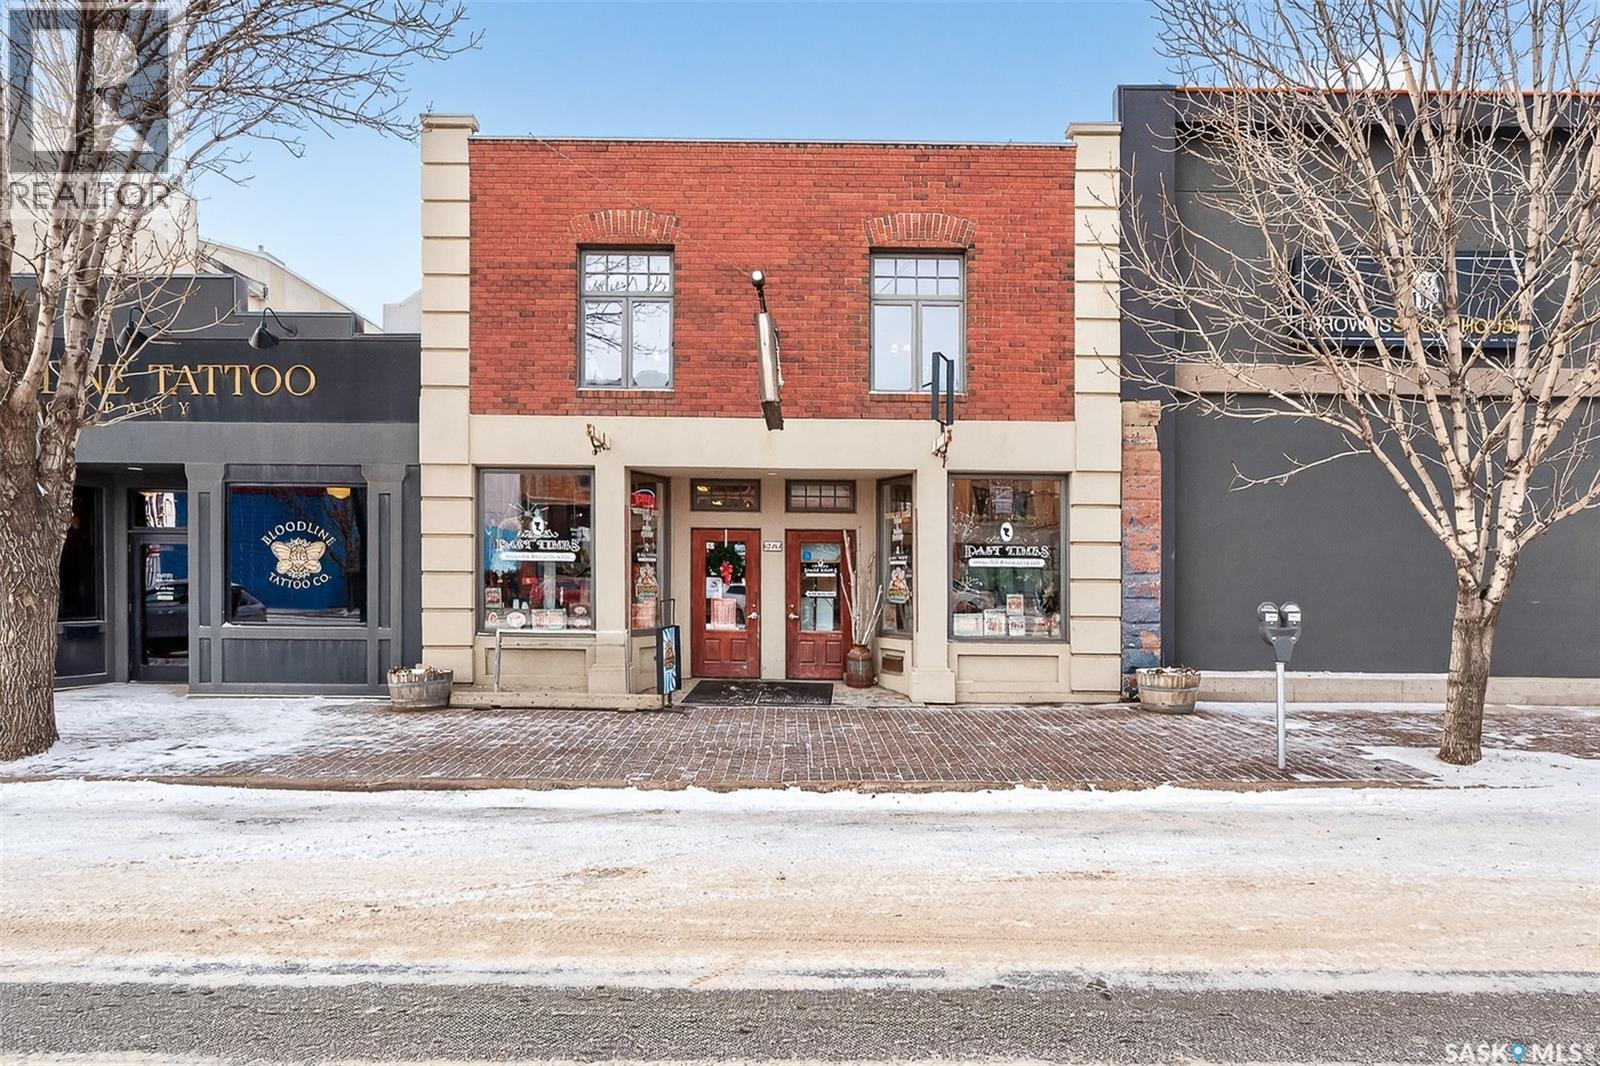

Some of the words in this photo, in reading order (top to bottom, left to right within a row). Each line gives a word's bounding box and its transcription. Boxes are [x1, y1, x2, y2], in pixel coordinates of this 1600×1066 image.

[148, 363, 317, 397] TATTOO
[261, 521, 336, 546] BLOODLINE
[964, 545, 1003, 558] PAST
[269, 572, 311, 589] TATTOO
